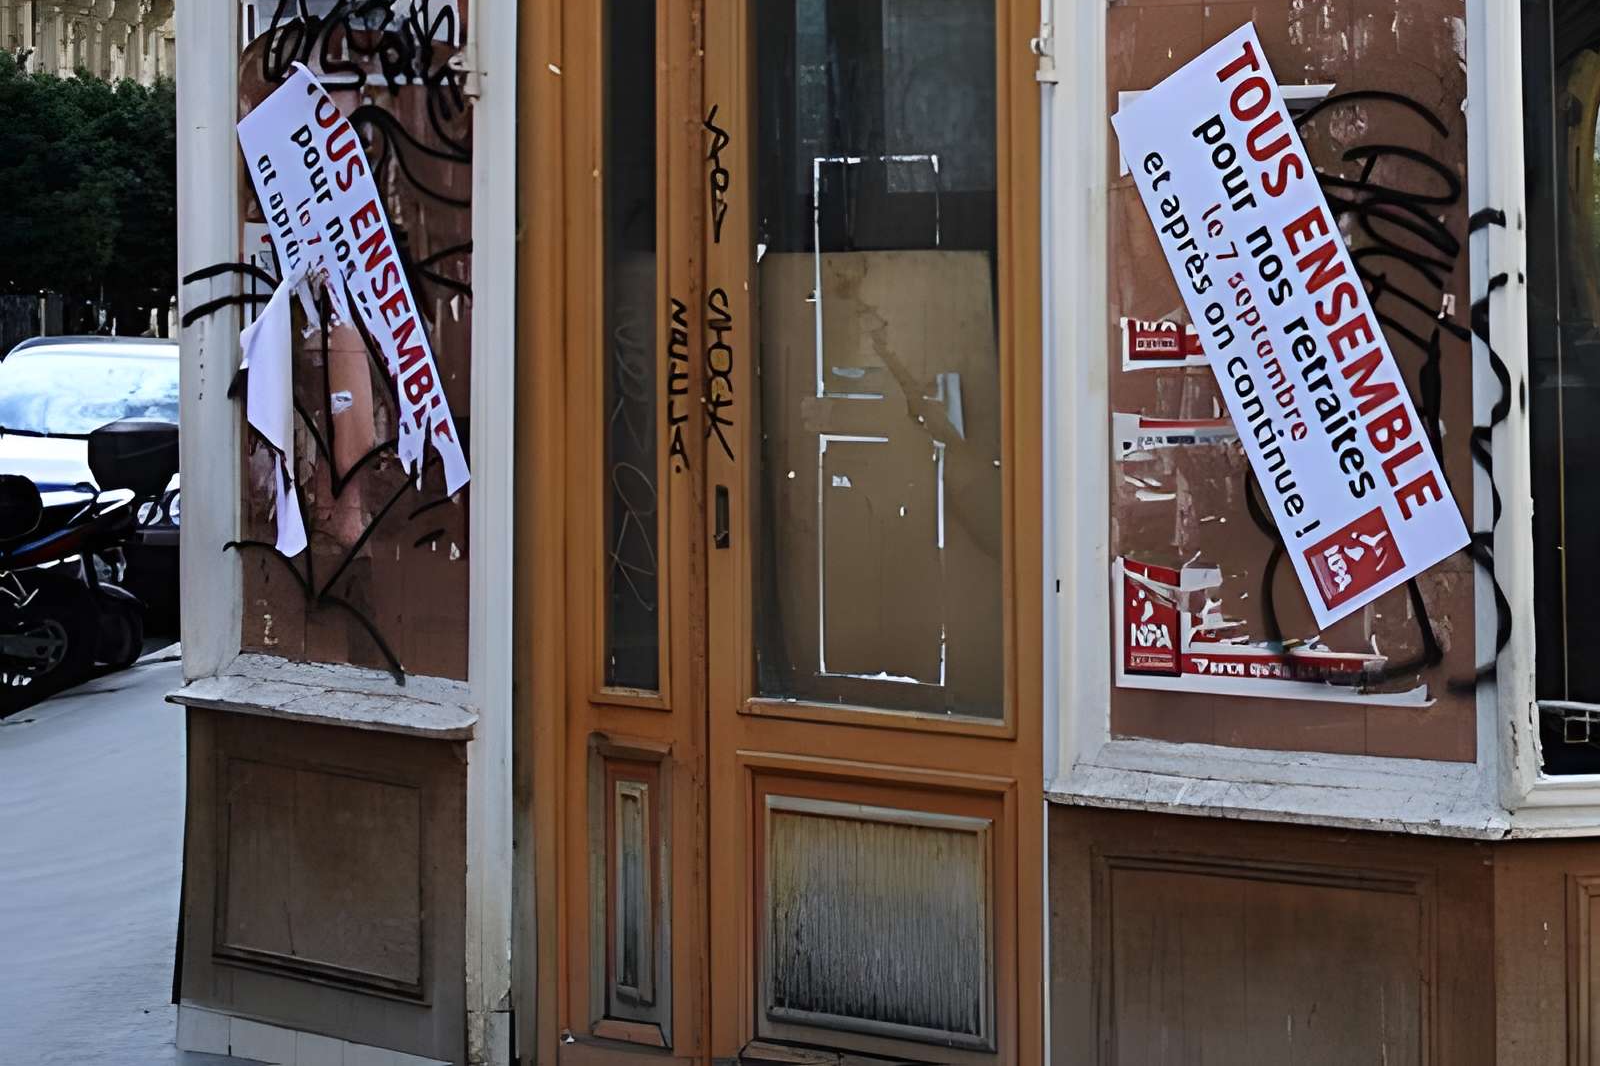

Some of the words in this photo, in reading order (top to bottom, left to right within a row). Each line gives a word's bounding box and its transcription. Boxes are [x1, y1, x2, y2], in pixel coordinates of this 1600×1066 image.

[290, 124, 333, 204] pour
[1143, 151, 1171, 192] et
[1160, 195, 1213, 295] après
[1204, 302, 1235, 350] on
[1227, 356, 1305, 517] continue
[1192, 113, 1257, 212] pour
[1246, 225, 1293, 307] nos
[1283, 316, 1376, 500] retraites
[1201, 202, 1225, 237] le
[1214, 241, 1240, 261] 7
[1227, 271, 1309, 441] septembre
[1216, 41, 1304, 198] TOUS
[1284, 206, 1442, 521] ENSEMBLE
